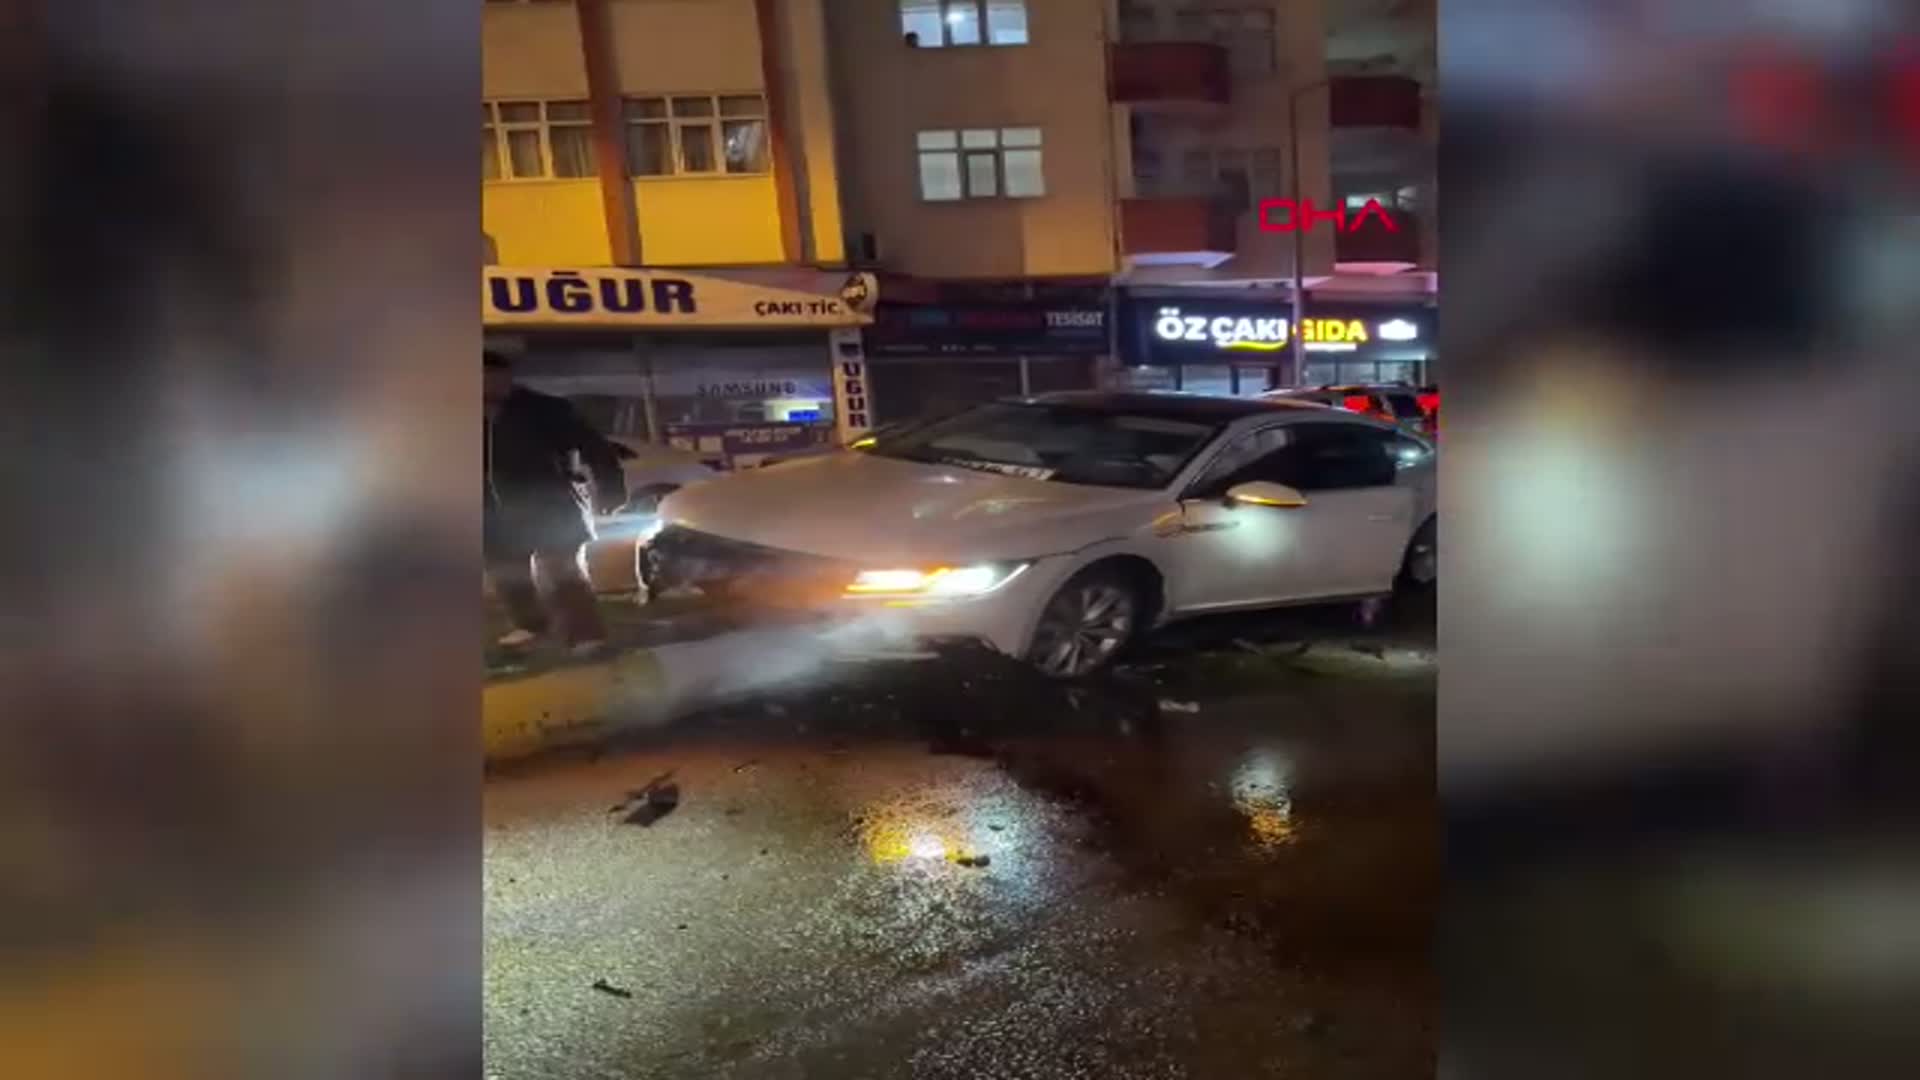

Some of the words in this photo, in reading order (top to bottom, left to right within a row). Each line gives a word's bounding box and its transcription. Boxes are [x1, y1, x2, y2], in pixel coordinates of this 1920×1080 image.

[489, 271, 698, 313] UĞUR
[754, 301, 802, 316] ÇAKI
[1156, 307, 1207, 341] ÖZ
[1210, 317, 1288, 347] ÇAKI
[697, 382, 798, 397] SAMSUNG
